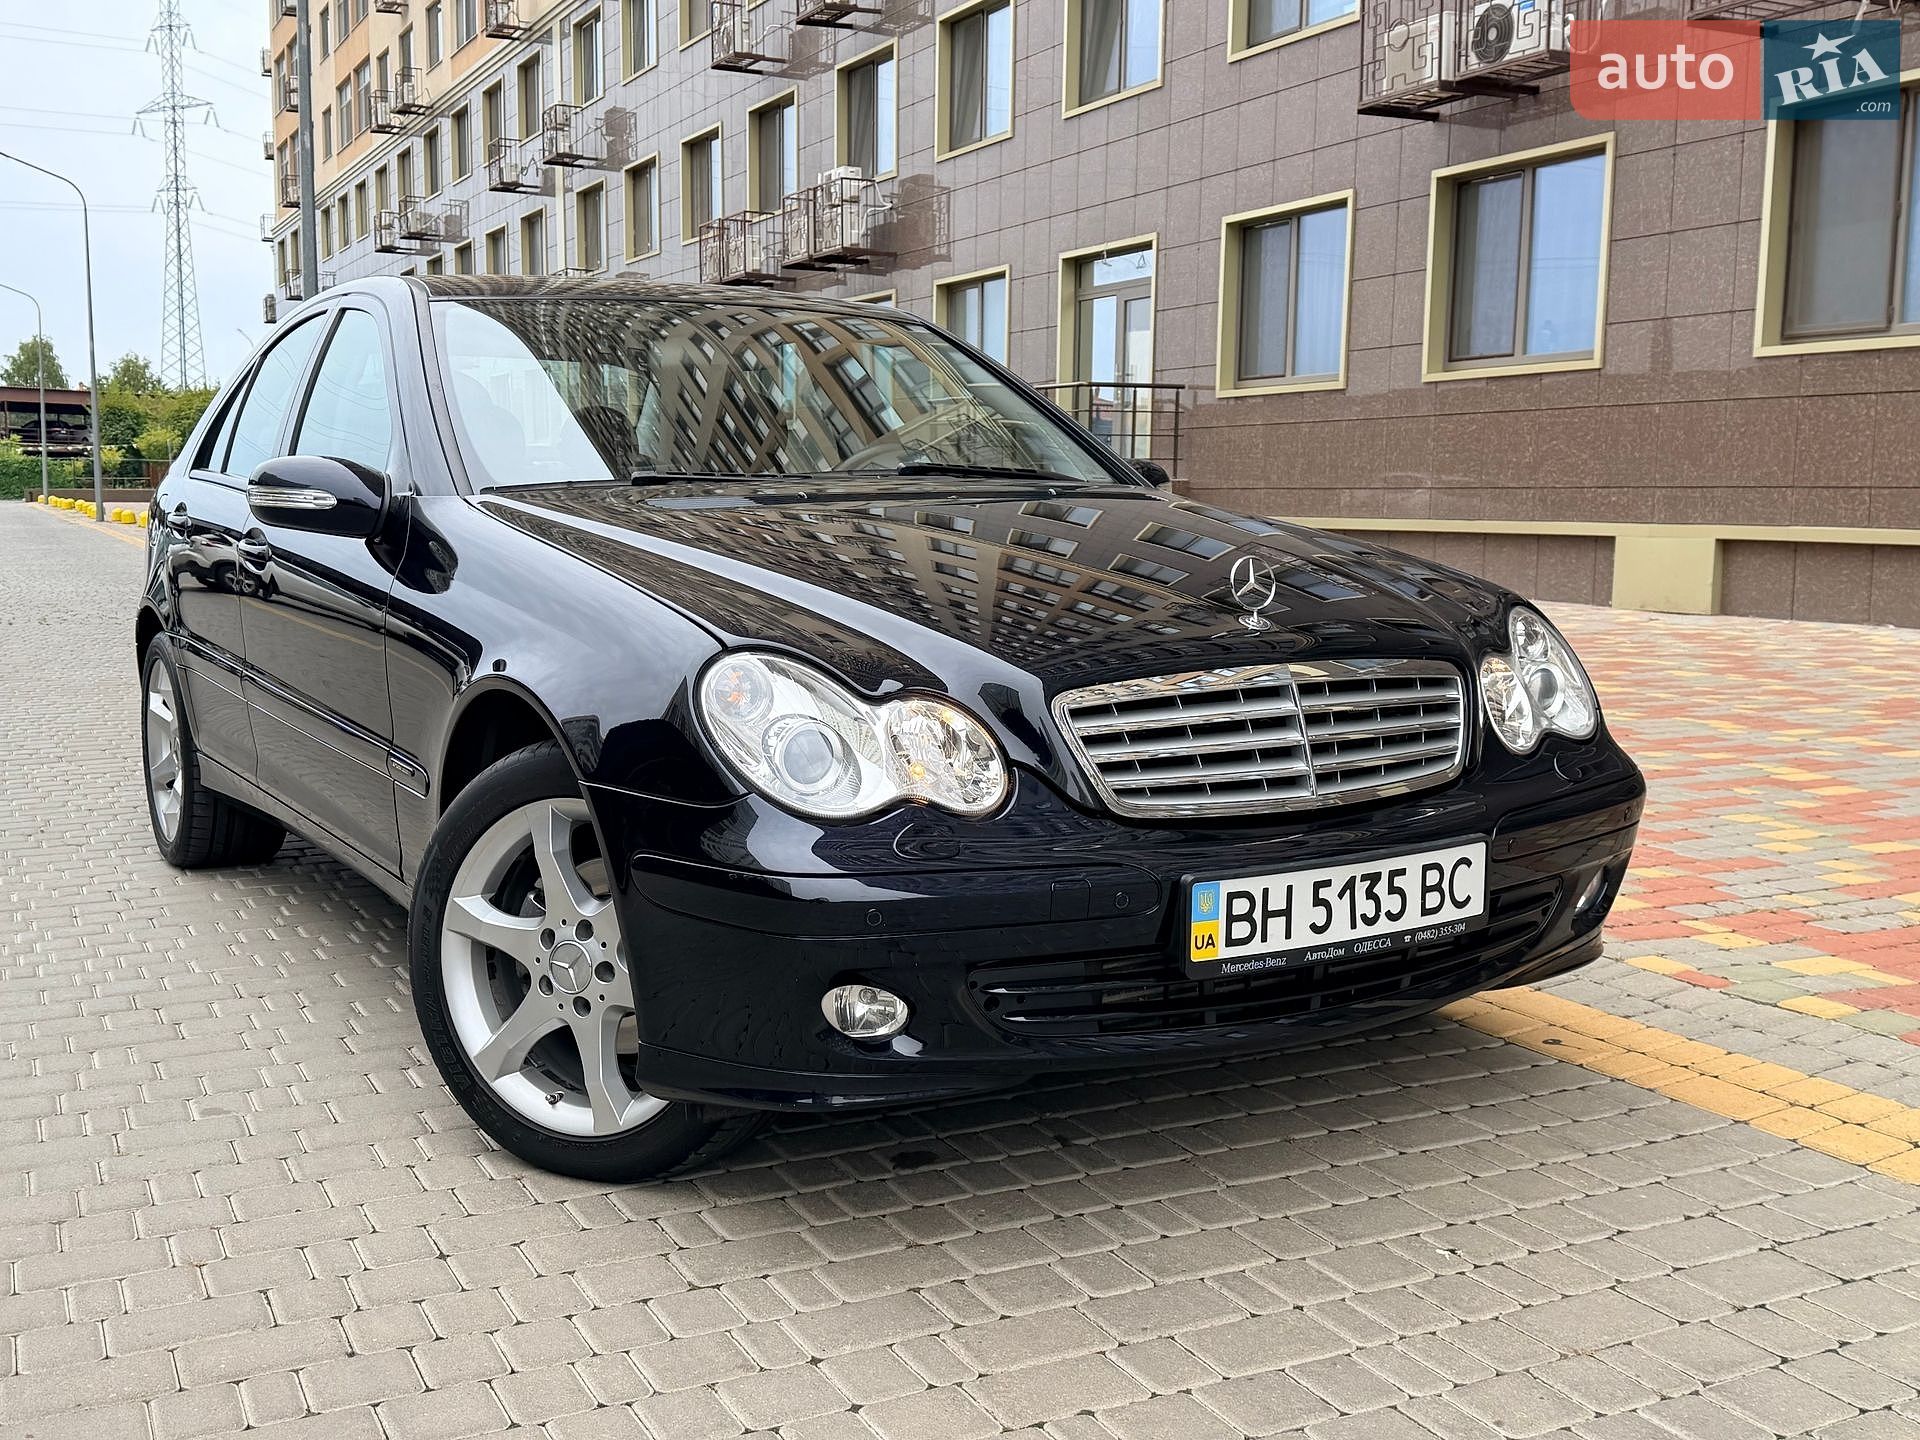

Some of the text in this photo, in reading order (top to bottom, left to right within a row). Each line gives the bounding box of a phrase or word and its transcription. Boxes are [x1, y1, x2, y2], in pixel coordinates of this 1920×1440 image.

[1224, 856, 1473, 948] BH 5135 BC
[1194, 932, 1216, 950] UA
[1414, 922, 1466, 944] (0482) 355-304
[1304, 937, 1392, 962] АвтоДом ОДЕССА
[1221, 956, 1287, 974] Mercedes-Benz
